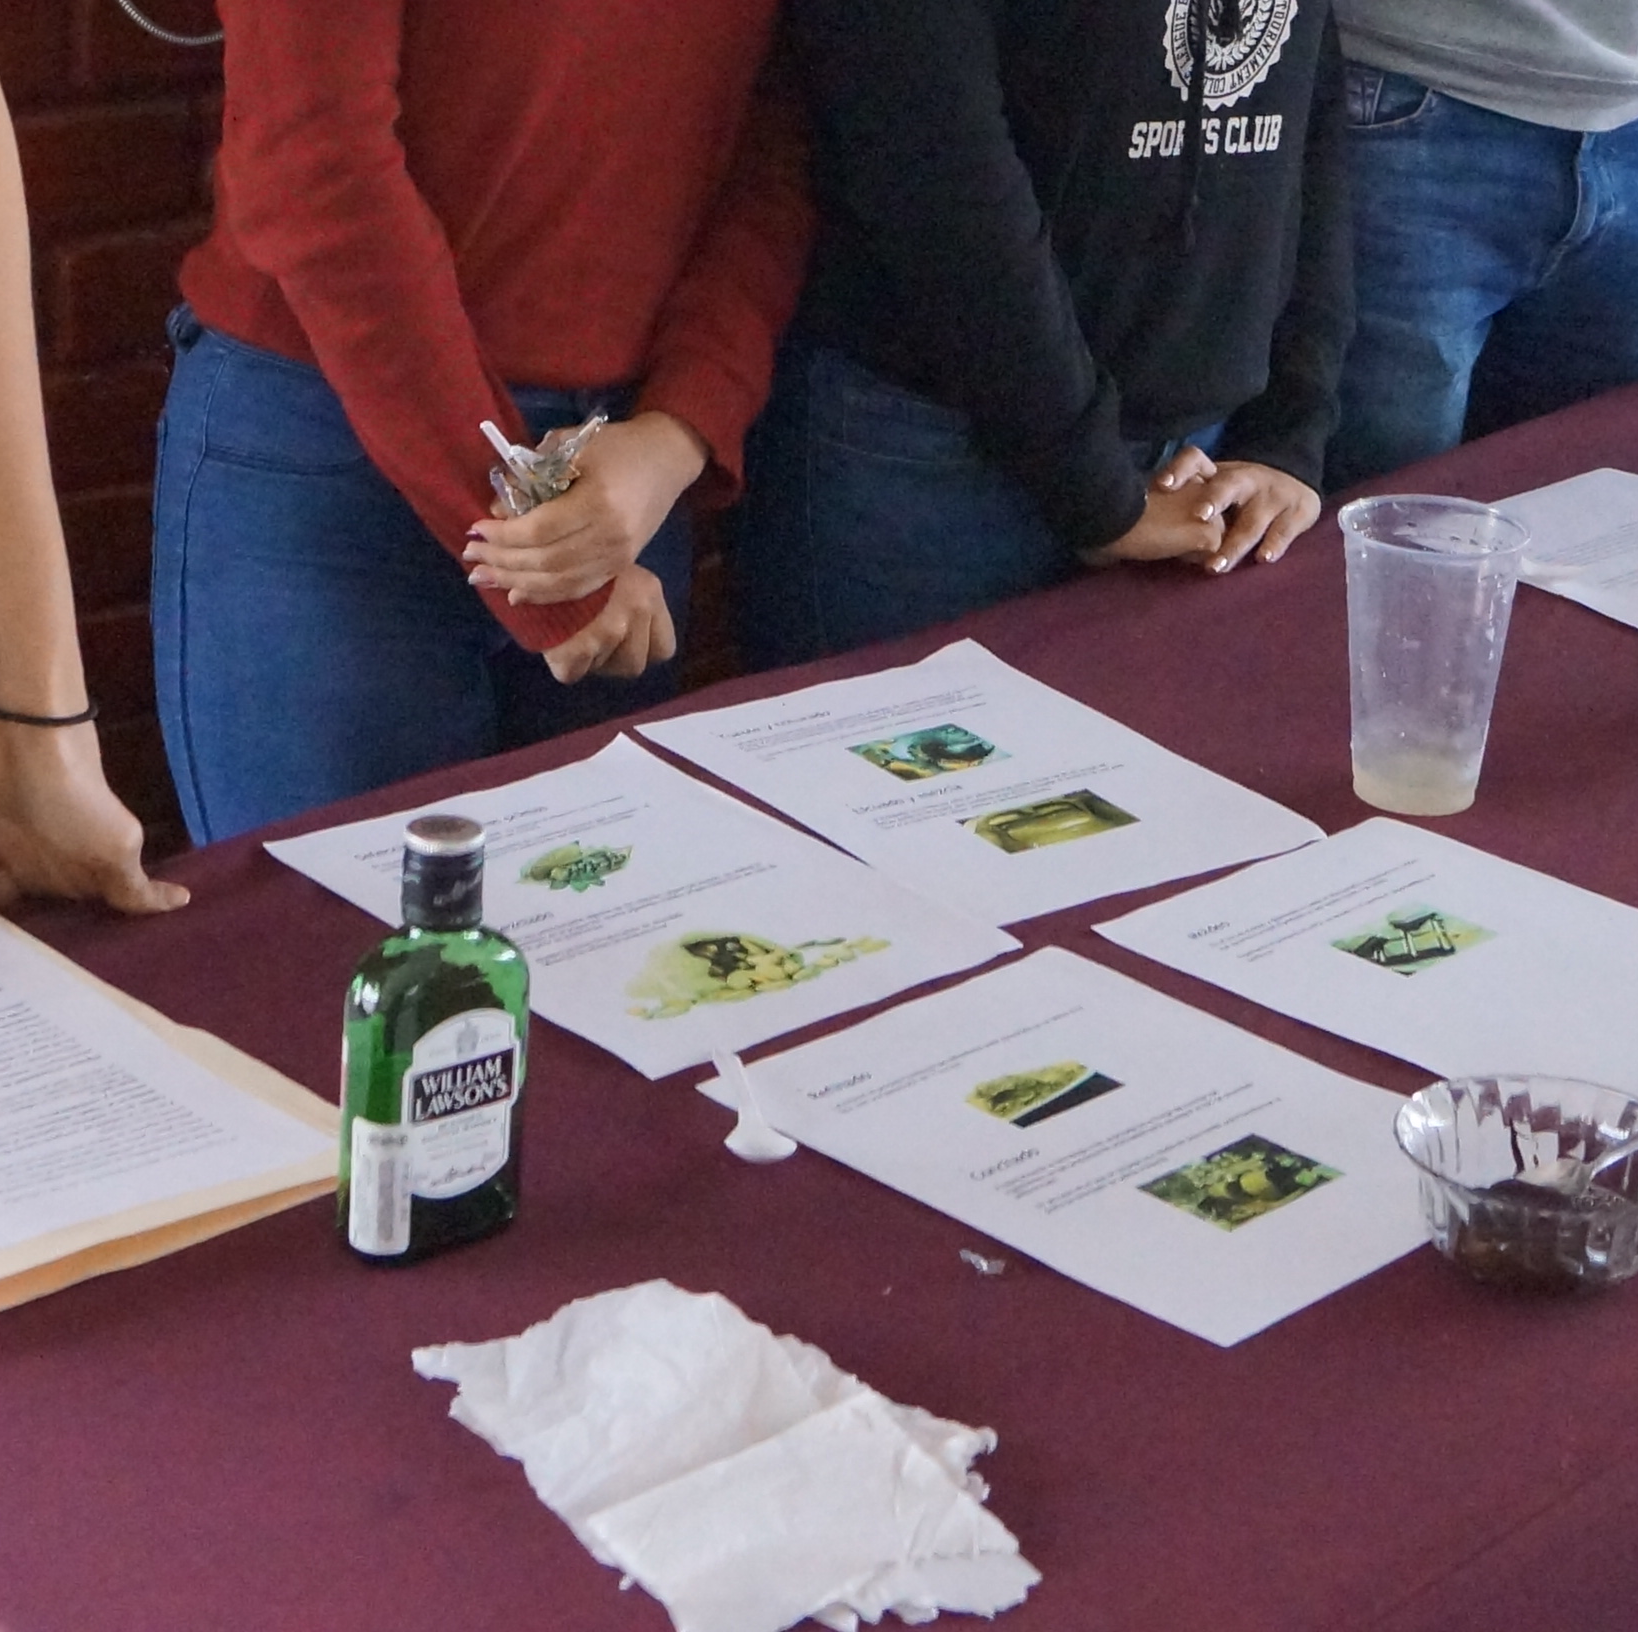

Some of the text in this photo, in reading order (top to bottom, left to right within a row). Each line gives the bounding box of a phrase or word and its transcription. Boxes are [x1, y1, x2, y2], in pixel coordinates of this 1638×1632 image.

[1225, 114, 1283, 154] CLUB
[421, 1055, 503, 1098] WILLIAM
[415, 1075, 509, 1122] LAWSON'S
